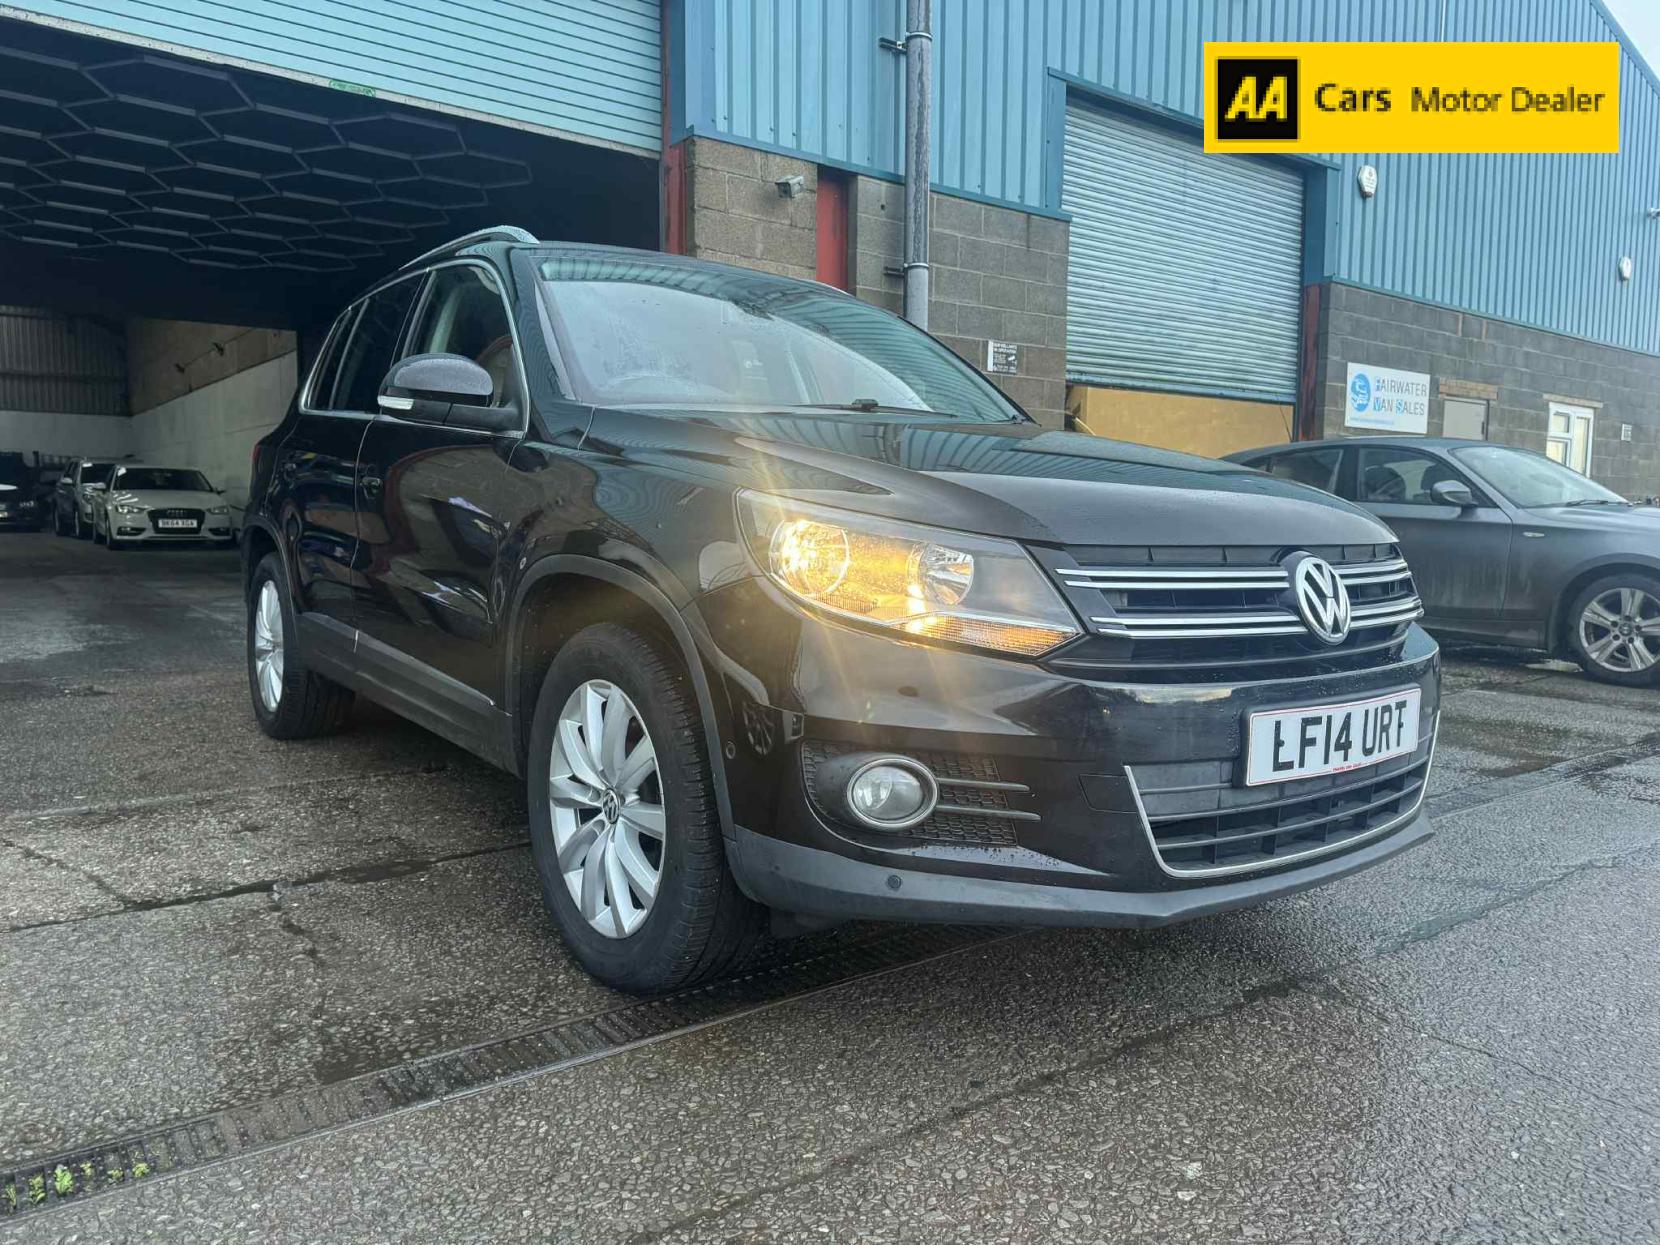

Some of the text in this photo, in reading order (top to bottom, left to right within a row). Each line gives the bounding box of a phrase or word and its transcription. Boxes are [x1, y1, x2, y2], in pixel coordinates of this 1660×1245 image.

[1375, 376, 1427, 397] FAIRWATER
[1373, 397, 1425, 416] VAN SALES
[1272, 700, 1407, 773] LF14 URT
